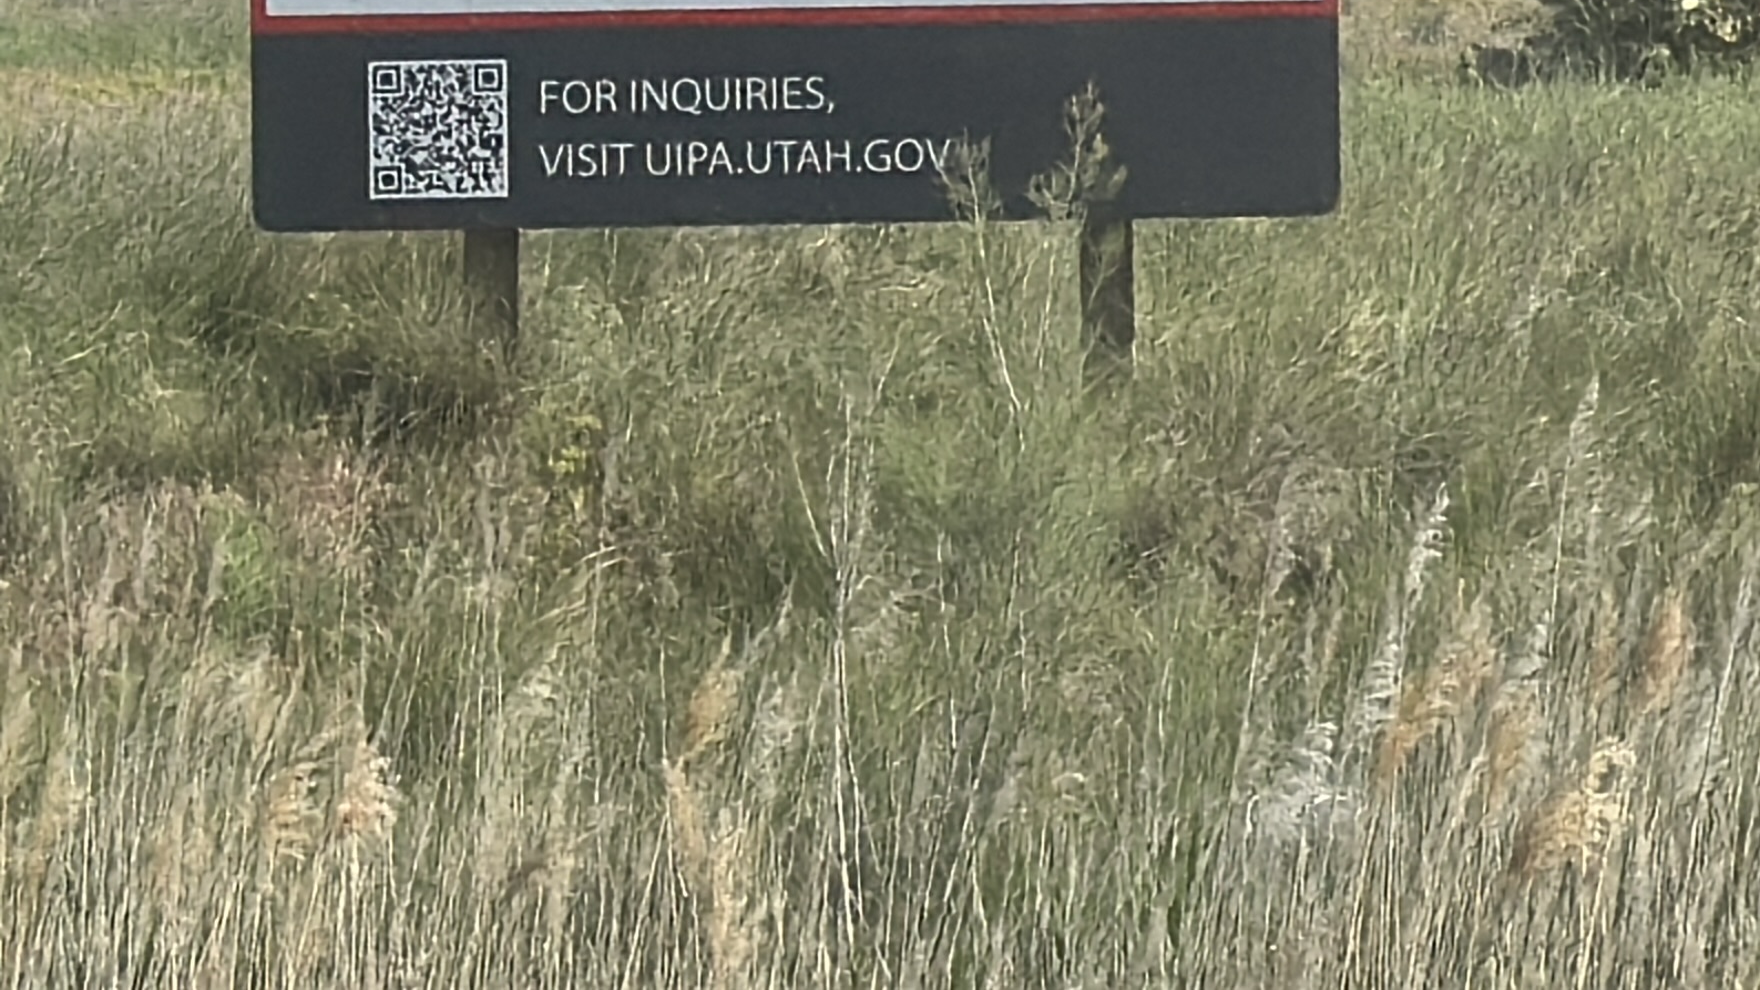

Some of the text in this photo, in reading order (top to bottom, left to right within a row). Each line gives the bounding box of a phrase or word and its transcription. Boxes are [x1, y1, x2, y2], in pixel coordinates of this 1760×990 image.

[541, 77, 834, 114] FOR INQUIRIES,
[539, 139, 950, 176] VISIT UIPA.UTAH.GOV
